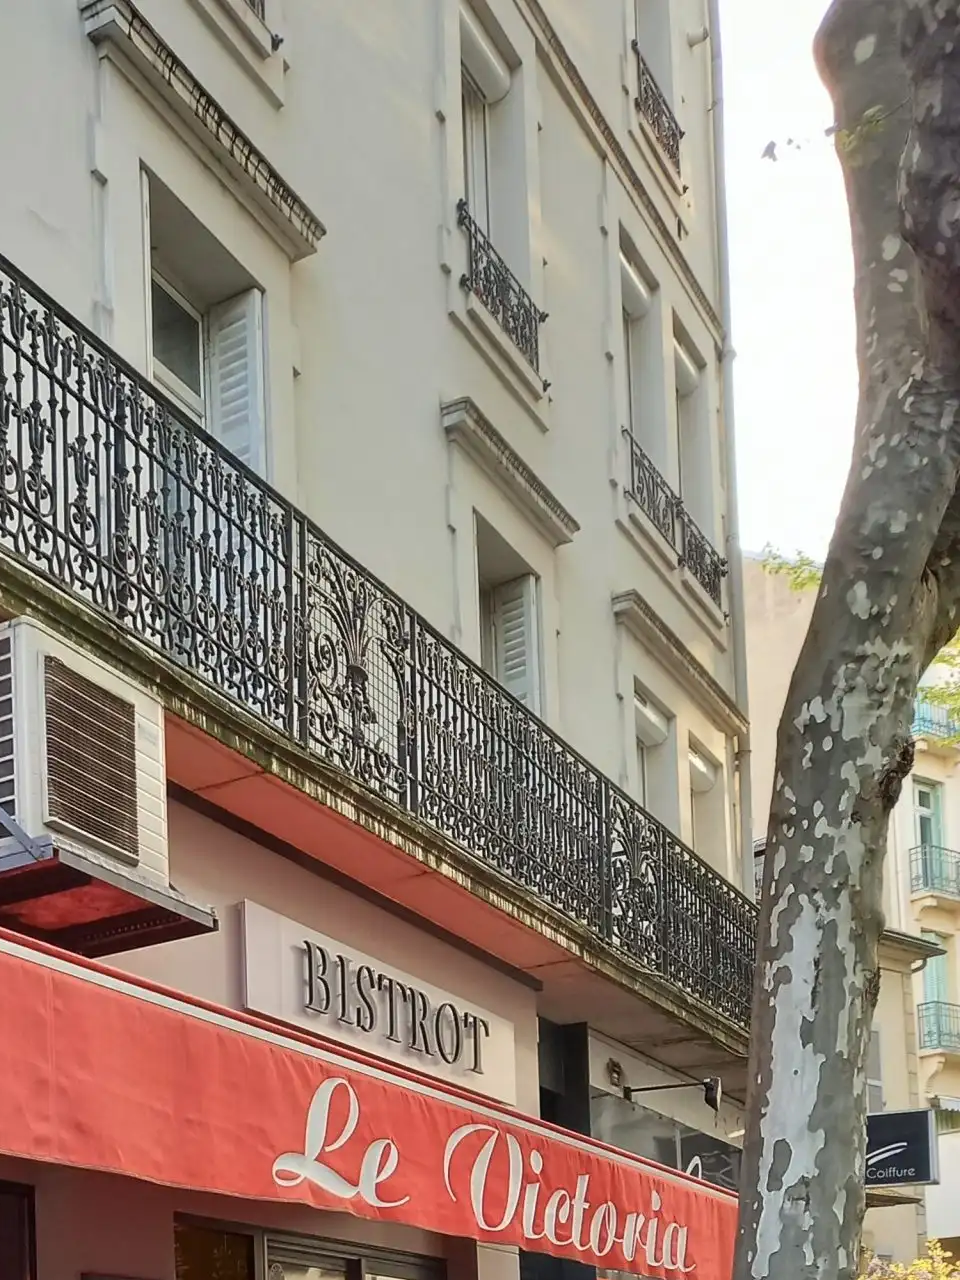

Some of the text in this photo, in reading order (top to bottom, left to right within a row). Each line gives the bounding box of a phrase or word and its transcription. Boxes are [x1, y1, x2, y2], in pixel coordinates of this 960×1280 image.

[302, 940, 490, 1076] BISTROT
[272, 1077, 696, 1273] Le Victoria
[866, 1167, 916, 1179] Coiffure
